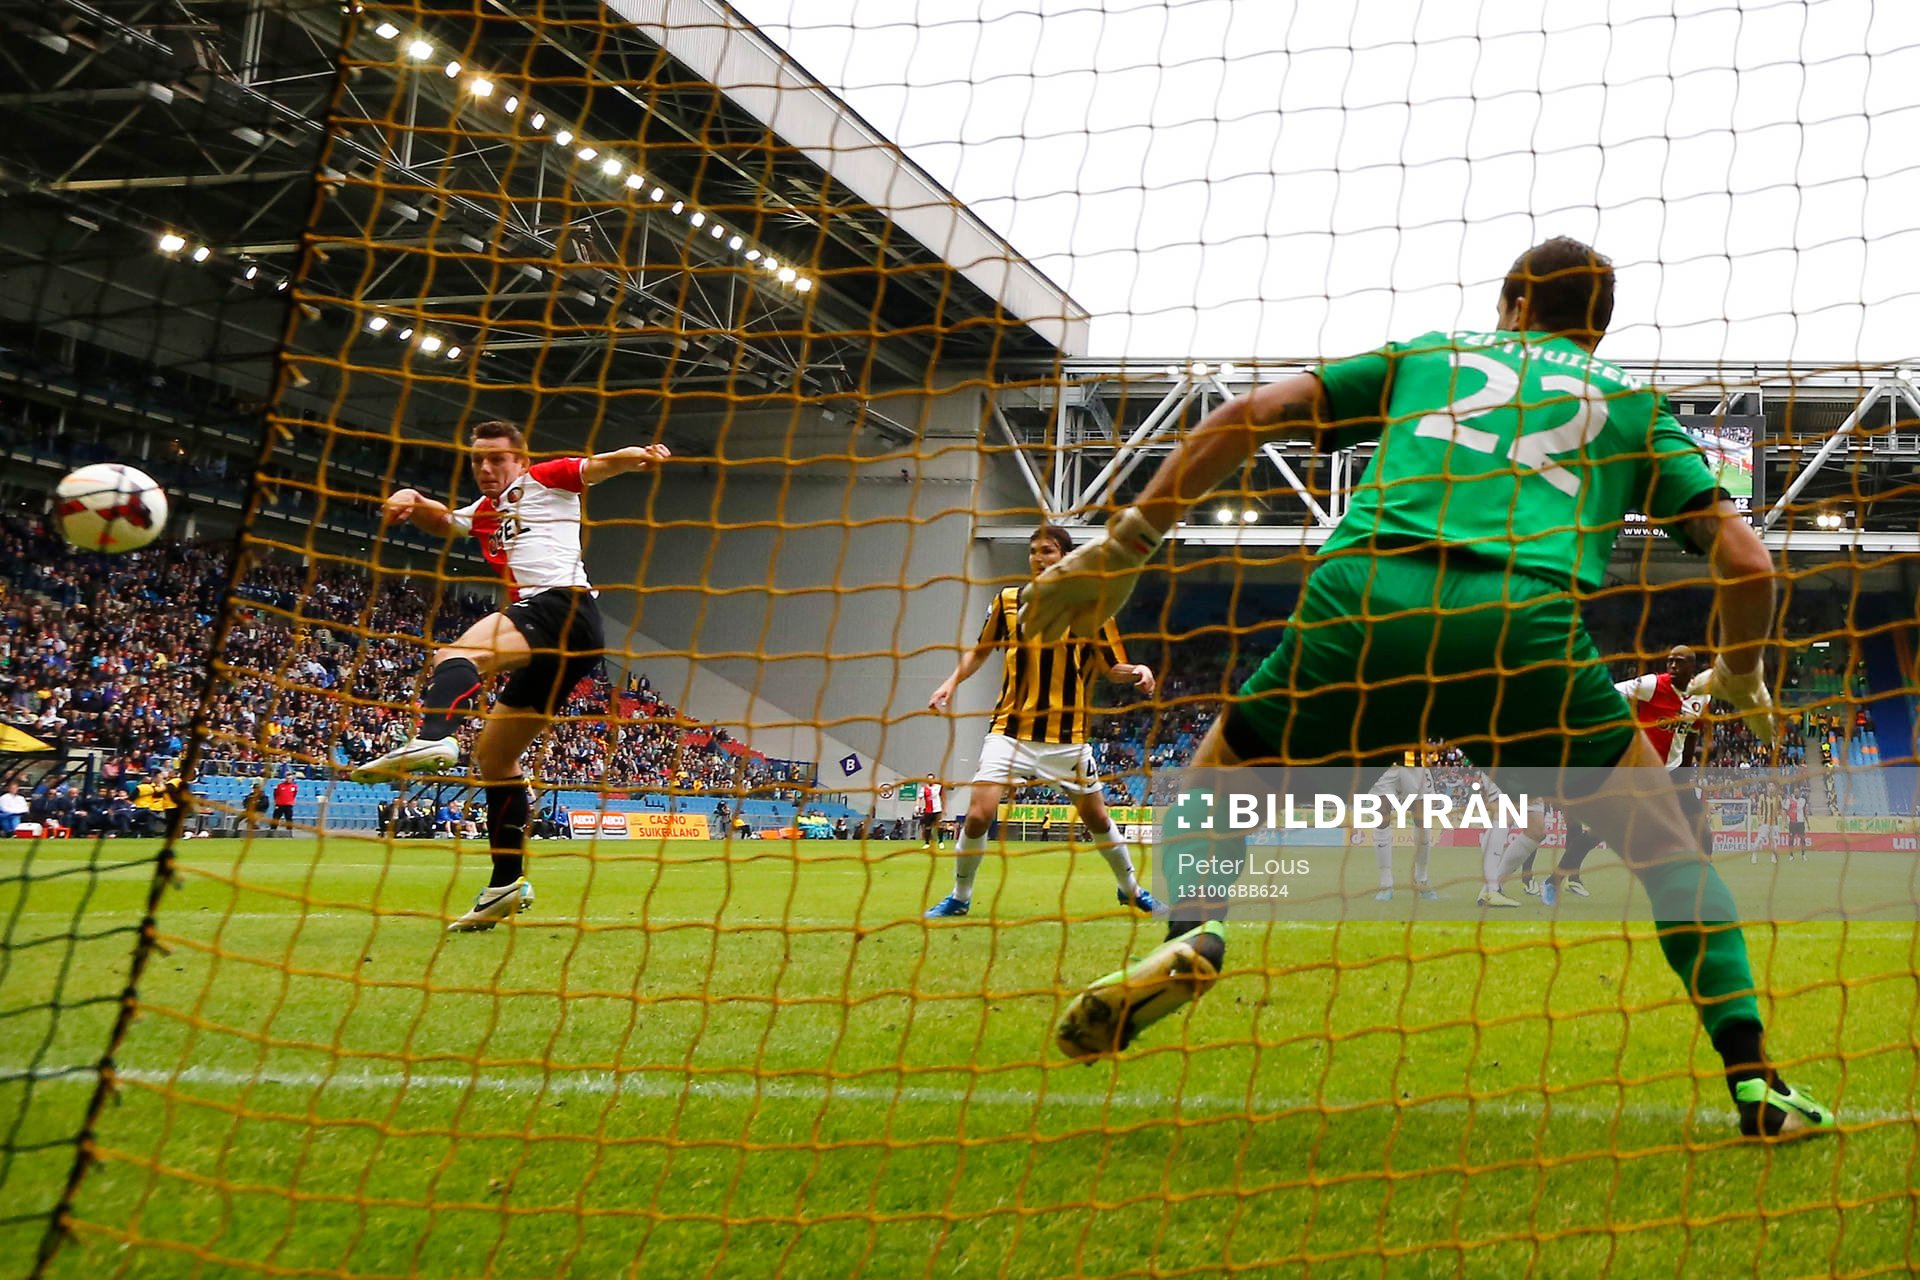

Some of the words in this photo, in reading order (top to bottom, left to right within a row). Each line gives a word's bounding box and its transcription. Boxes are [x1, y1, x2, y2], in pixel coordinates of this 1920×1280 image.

[1414, 352, 1608, 497] 22
[845, 758, 856, 771] B
[649, 814, 686, 825] CASINO
[639, 827, 700, 838] SUIKERLAND
